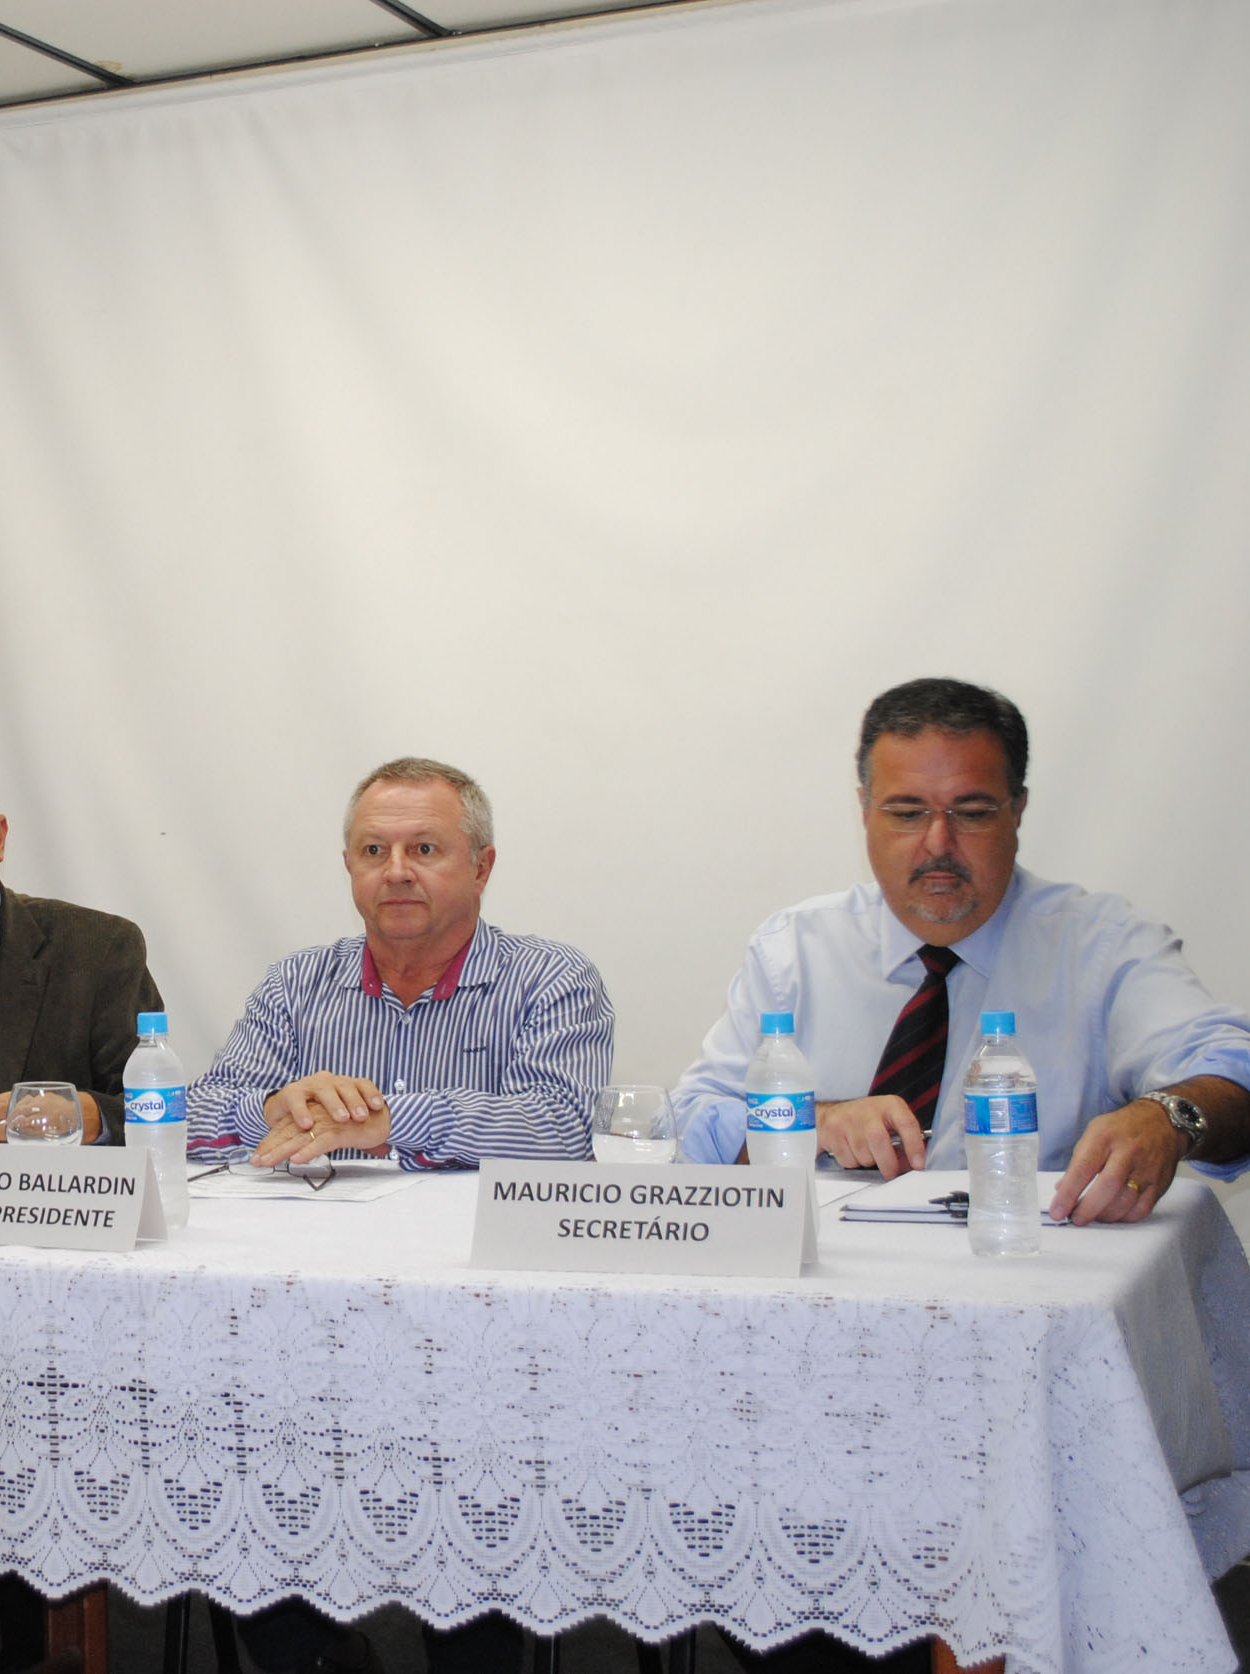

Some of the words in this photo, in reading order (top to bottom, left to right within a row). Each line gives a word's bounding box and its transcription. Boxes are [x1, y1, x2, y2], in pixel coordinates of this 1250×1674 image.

[129, 1099, 164, 1112] crystal
[754, 1106, 794, 1119] crystal
[18, 1172, 136, 1196] BALLARDIN
[493, 1181, 622, 1205] MAURICIO
[629, 1184, 785, 1209] GRAZZIOTIN
[557, 1215, 710, 1242] SECRETÁRIO
